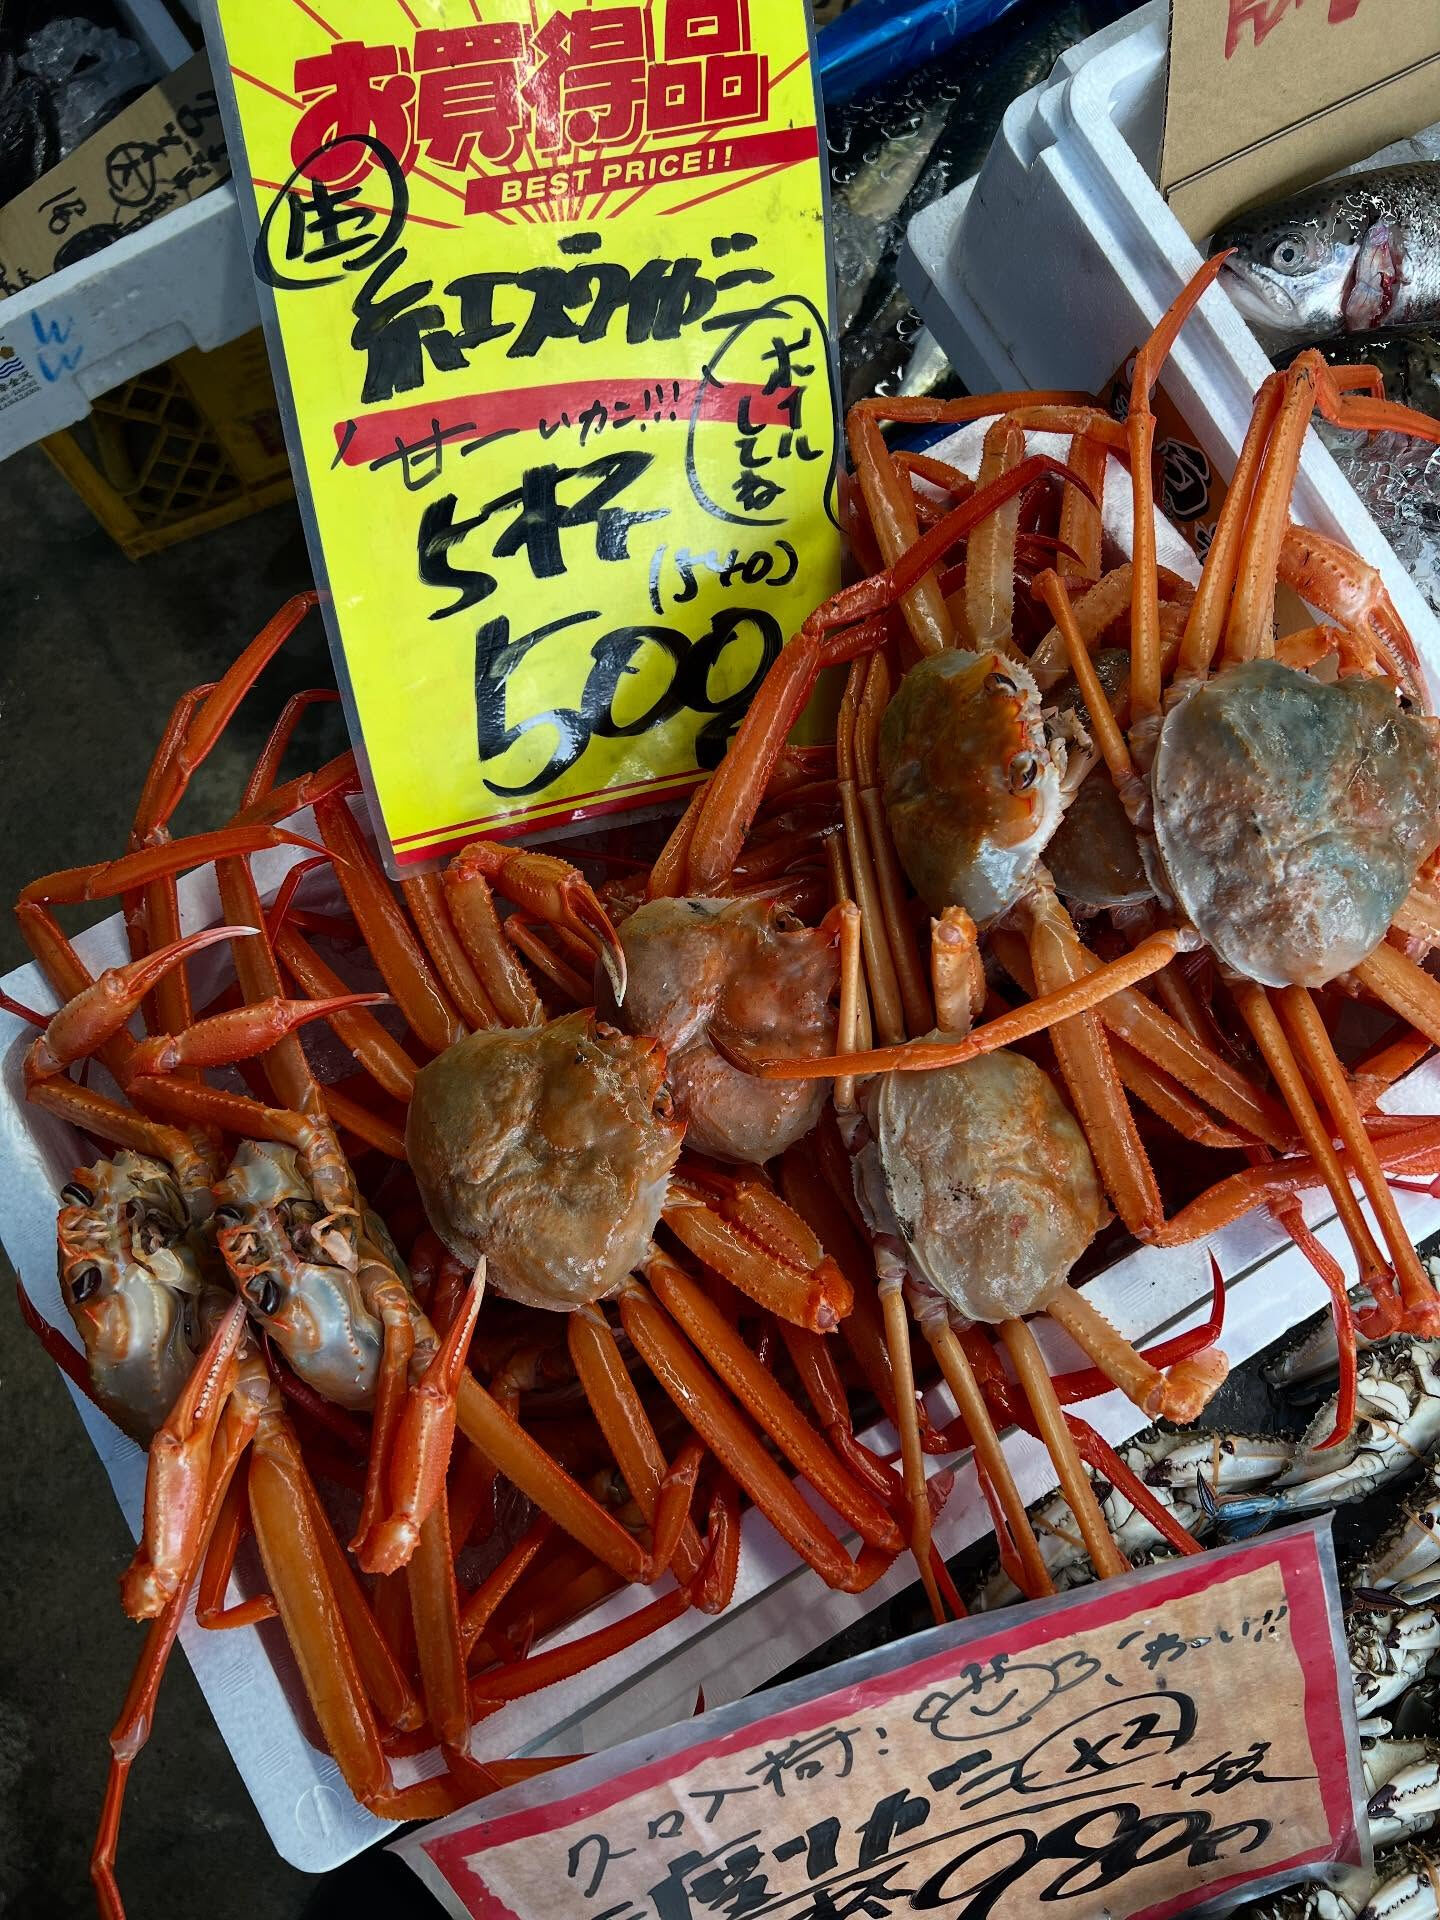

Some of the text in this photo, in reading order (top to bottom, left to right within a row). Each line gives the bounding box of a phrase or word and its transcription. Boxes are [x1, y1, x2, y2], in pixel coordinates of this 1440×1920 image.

[291, 0, 769, 187] お買得品
[501, 145, 733, 204] BEST PRICE!!
